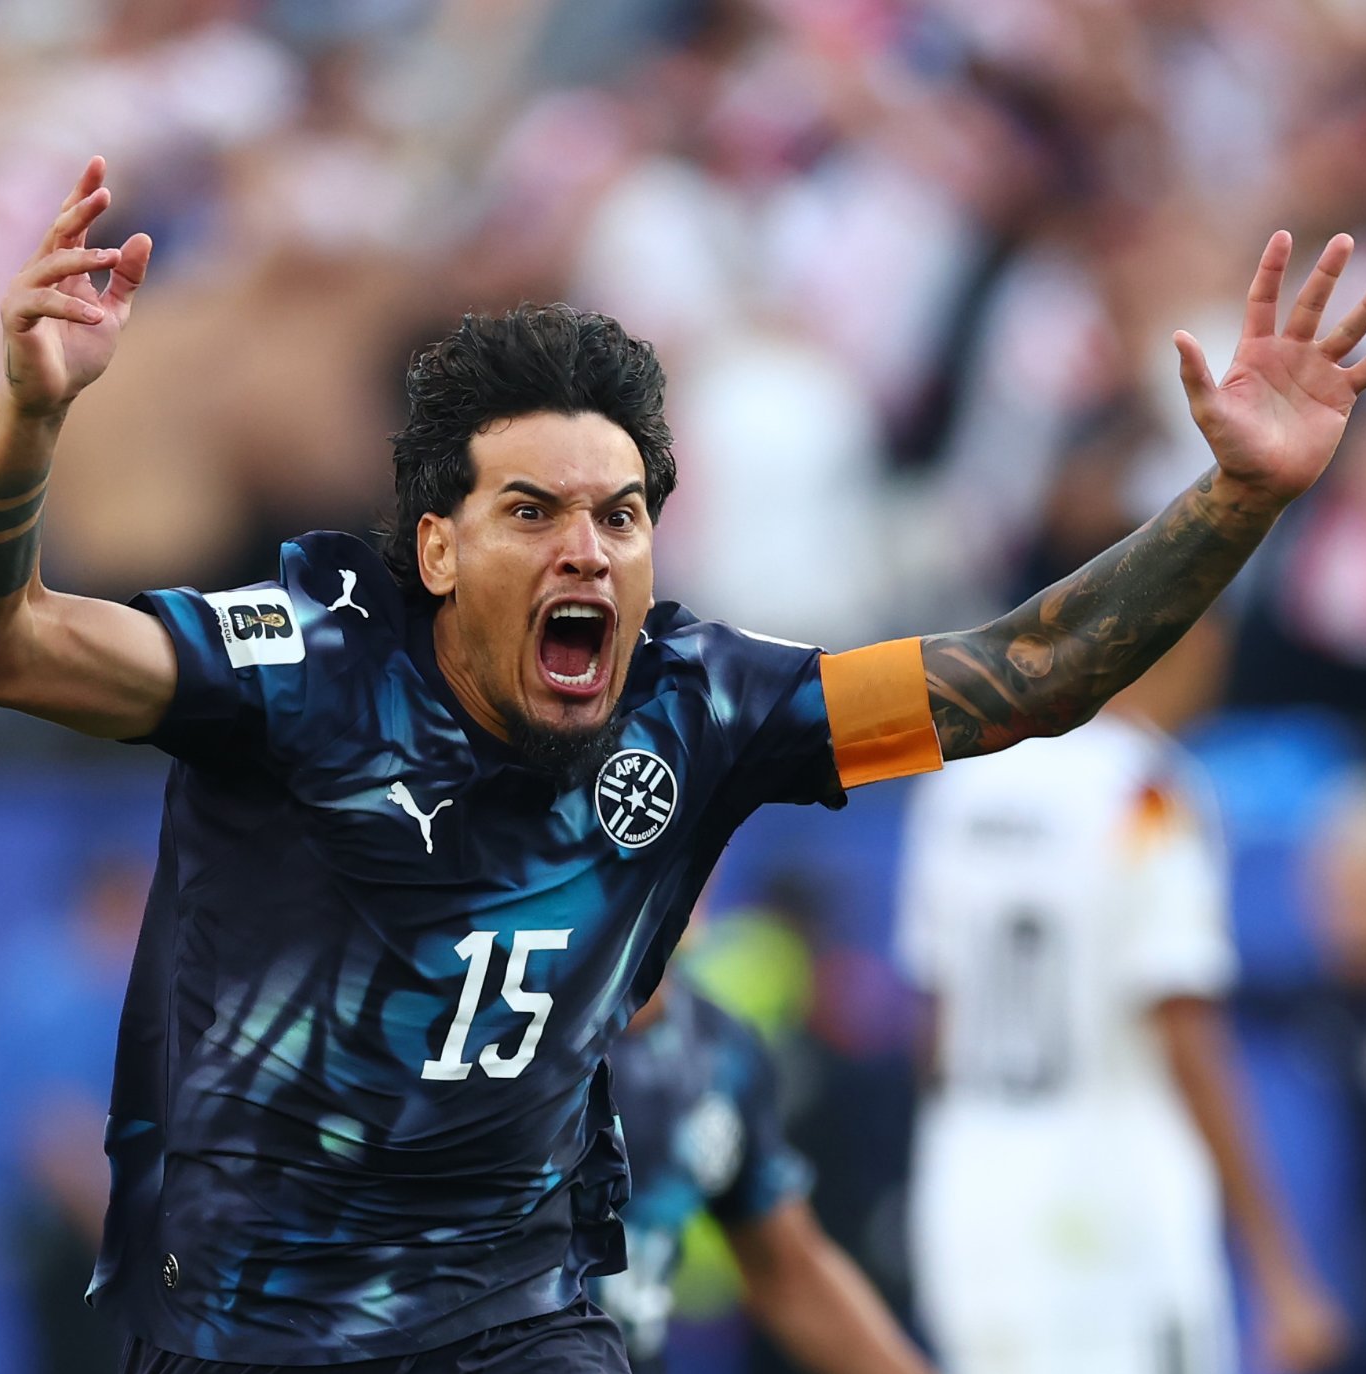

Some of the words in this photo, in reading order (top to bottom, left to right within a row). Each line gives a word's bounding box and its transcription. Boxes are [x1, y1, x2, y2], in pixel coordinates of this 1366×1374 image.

[234, 613, 246, 631] FIFA
[223, 627, 233, 644] CUP
[615, 755, 642, 778] APF
[623, 822, 659, 842] PARAGUAY
[421, 928, 575, 1081] 15
